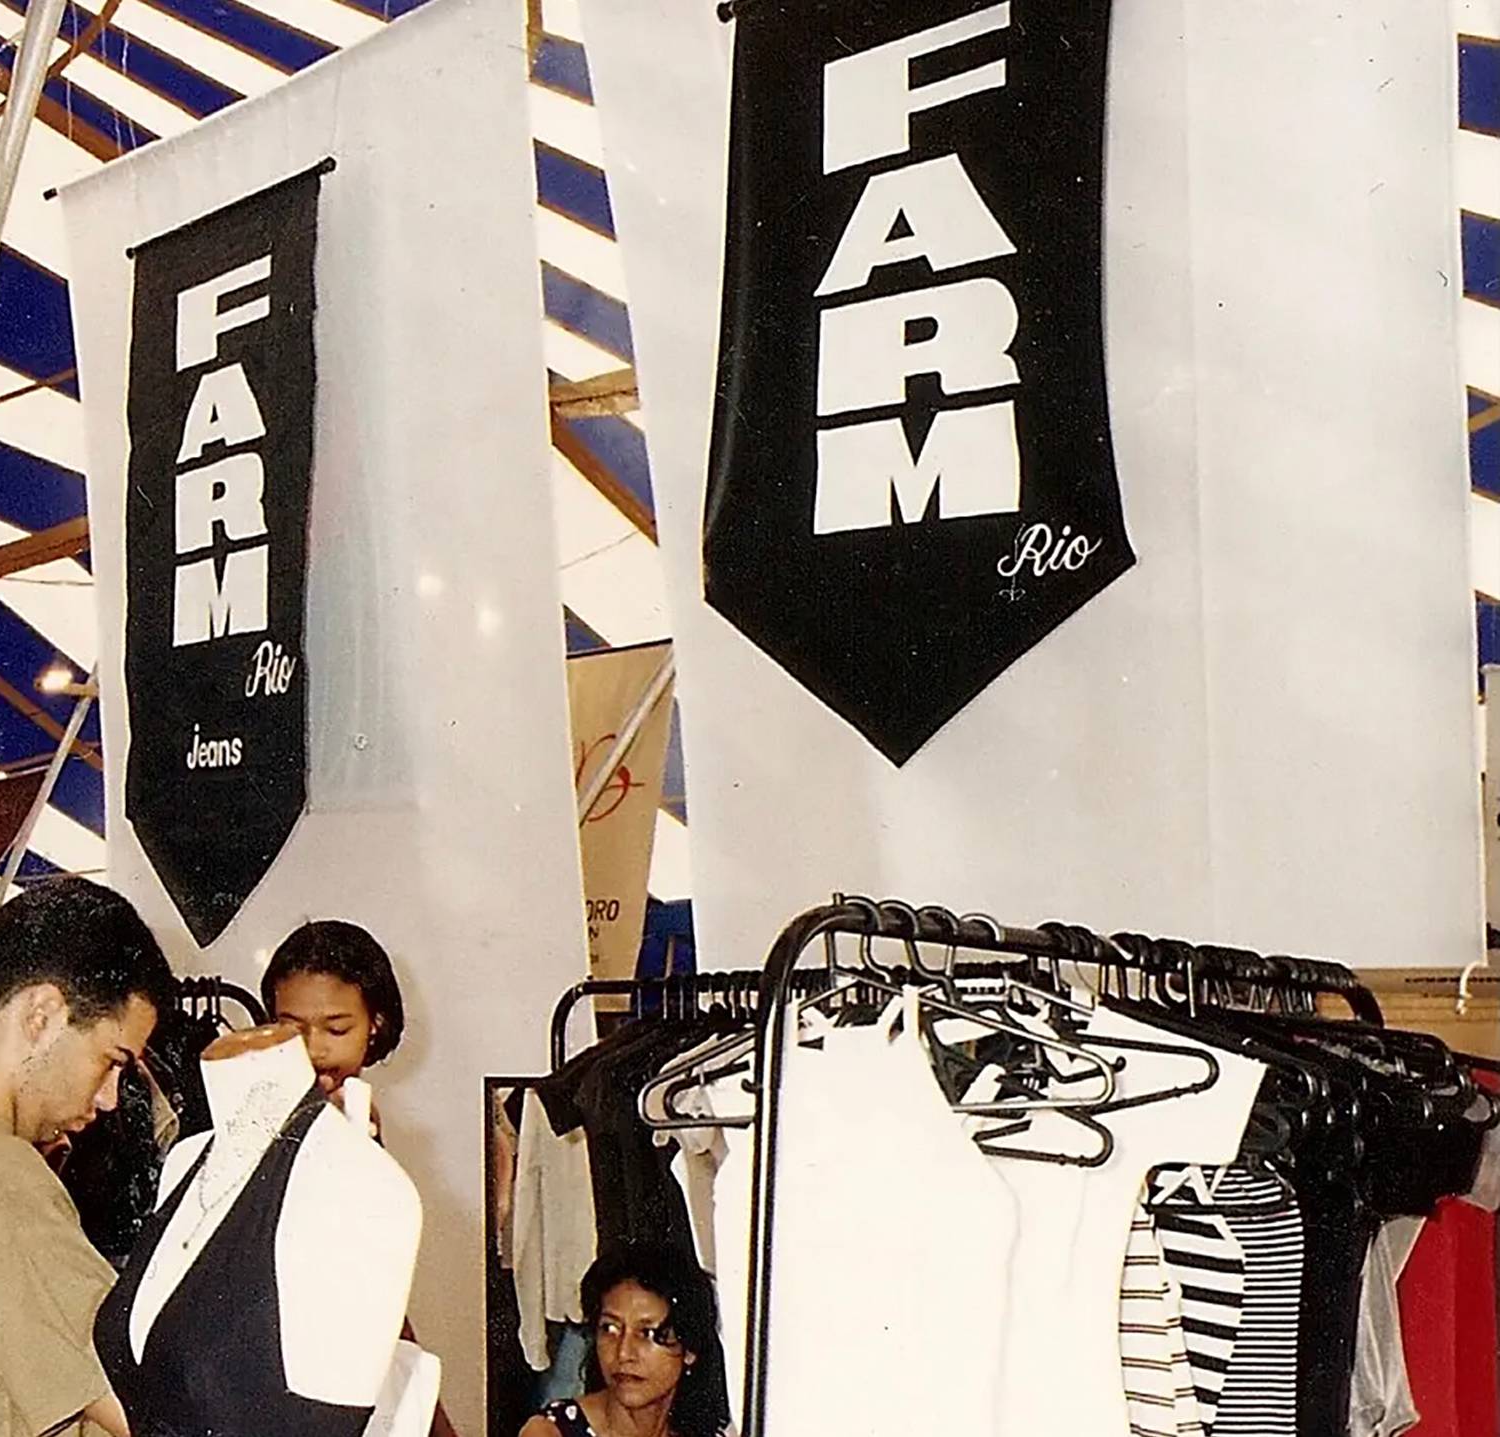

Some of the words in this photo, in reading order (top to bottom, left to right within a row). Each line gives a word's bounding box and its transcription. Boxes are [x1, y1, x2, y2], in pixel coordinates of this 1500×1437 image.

[813, 3, 1021, 535] FARM
[172, 253, 272, 649] FARM
[996, 522, 1103, 577] Rio
[245, 639, 297, 698] Rio
